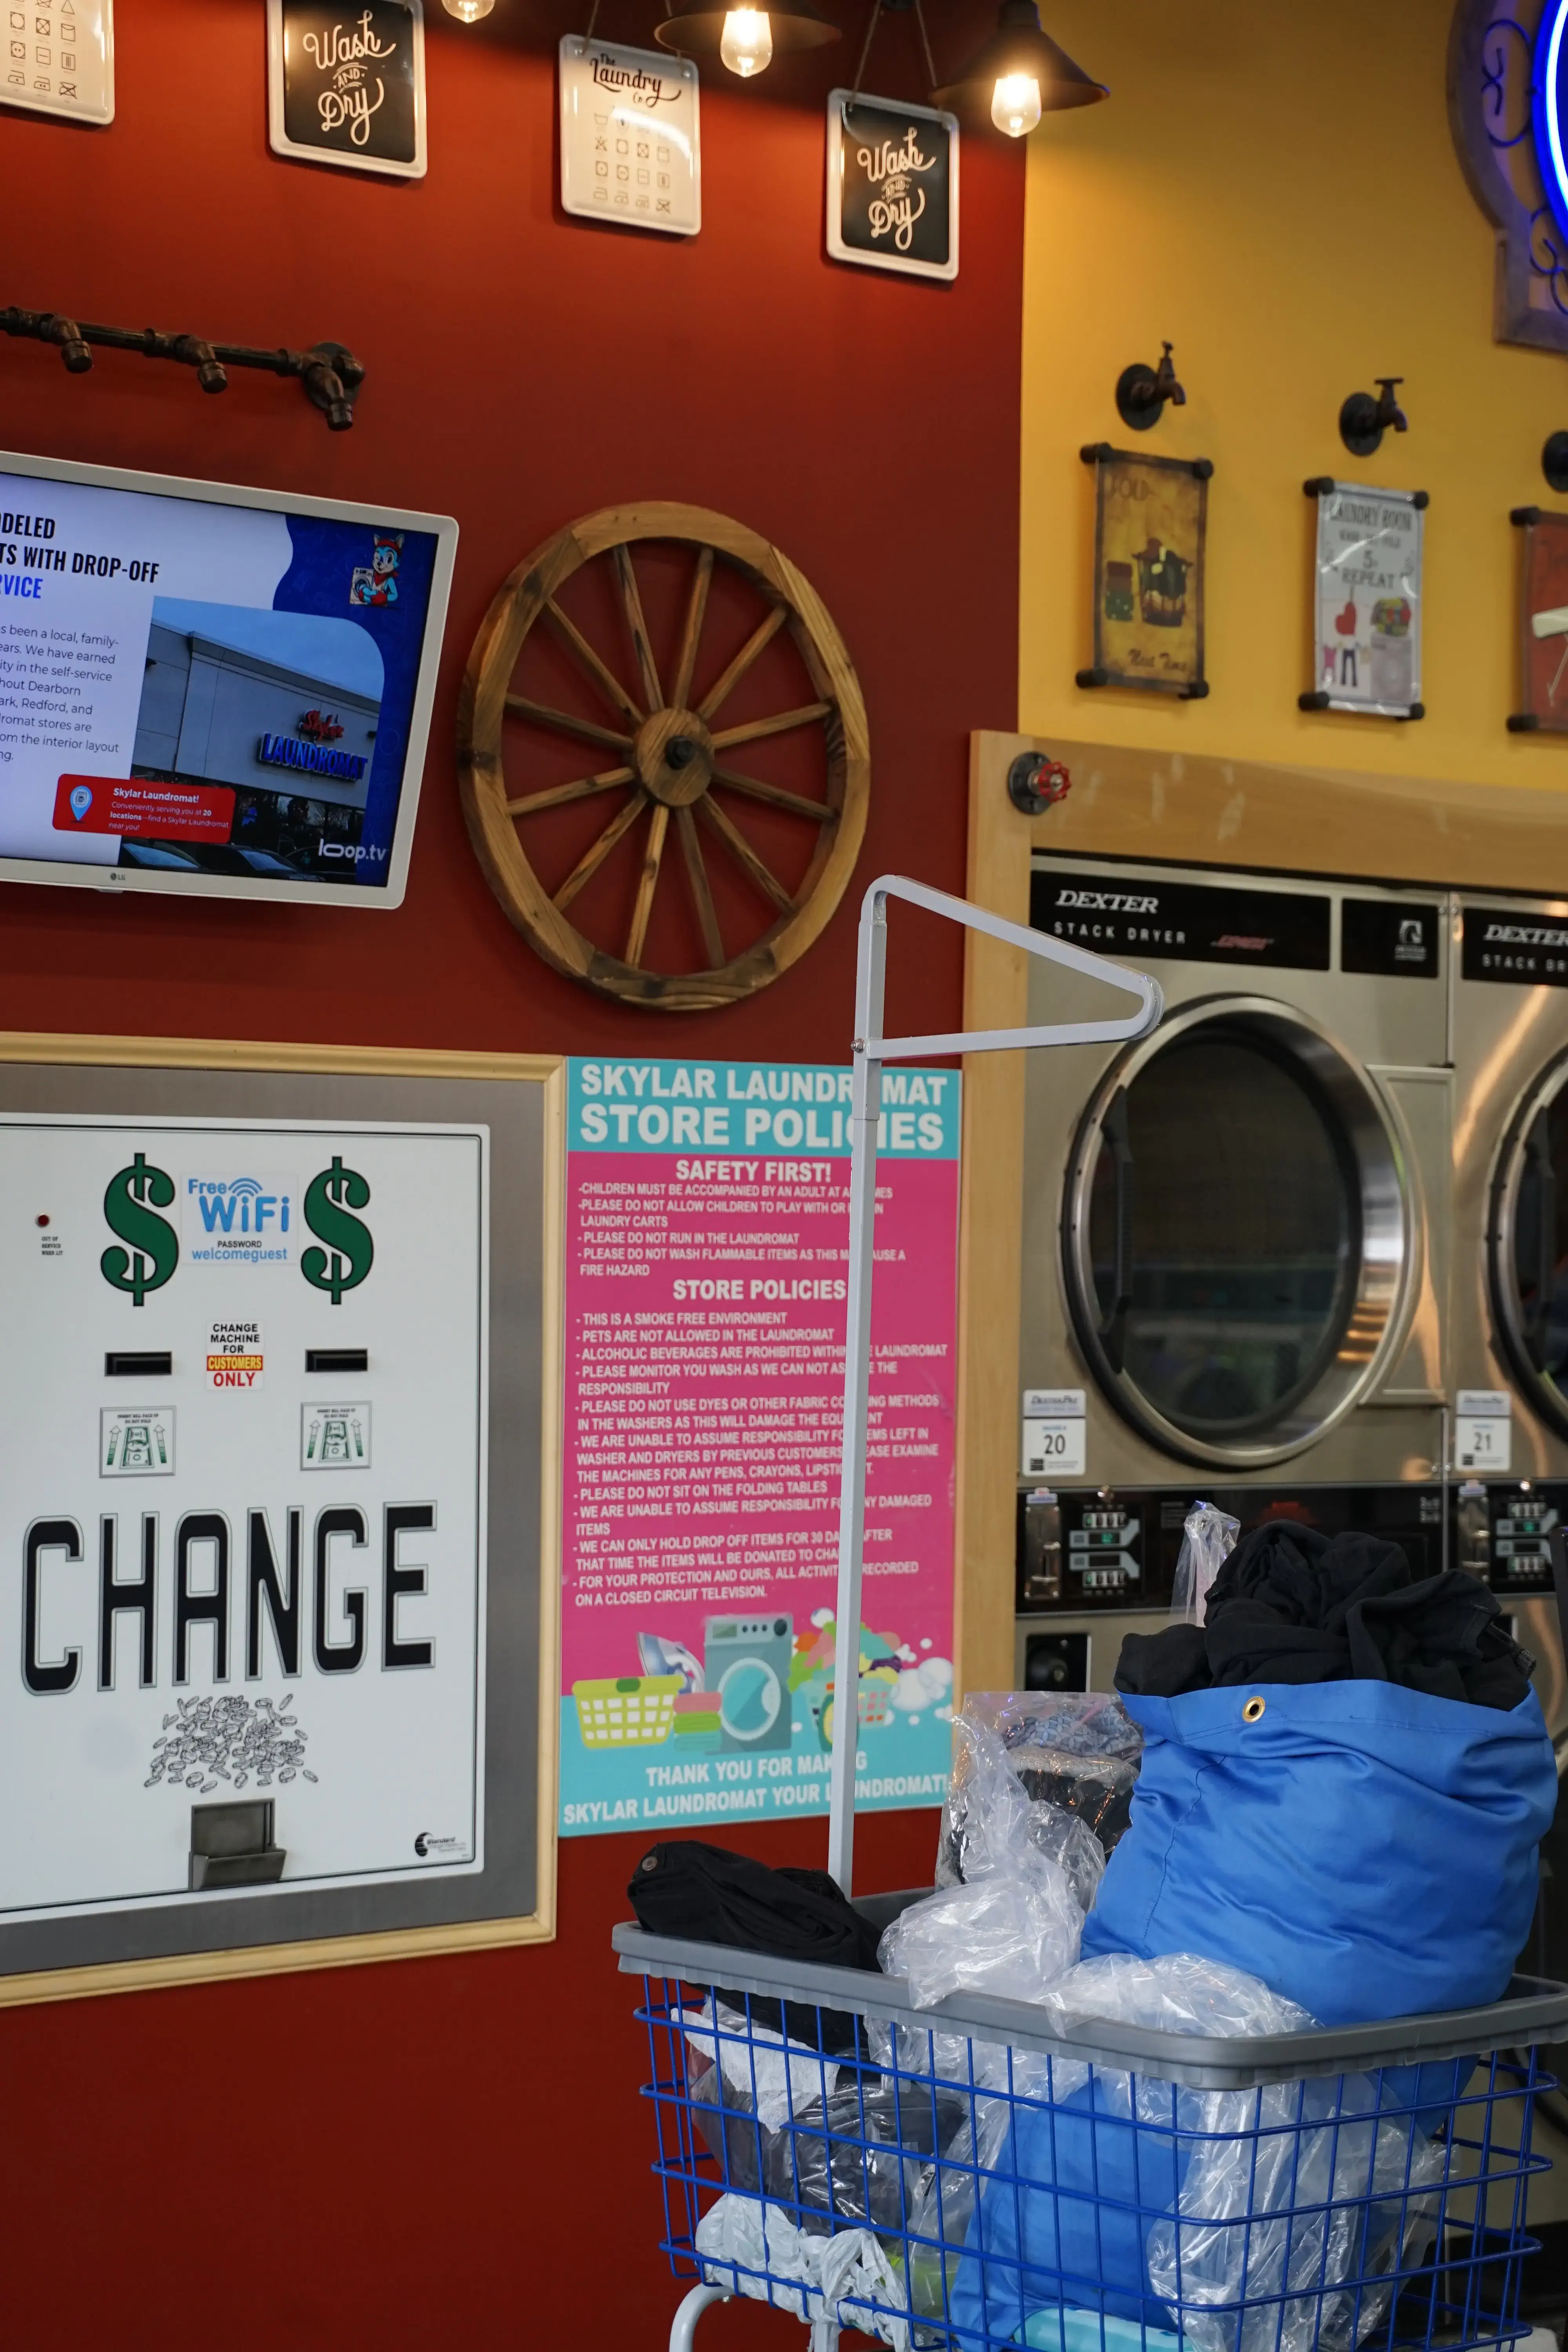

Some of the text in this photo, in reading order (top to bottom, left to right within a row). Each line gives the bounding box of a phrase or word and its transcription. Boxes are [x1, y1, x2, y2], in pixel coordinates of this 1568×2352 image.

[303, 9, 396, 70] Wash
[600, 53, 616, 66] The
[338, 68, 361, 88] AND
[590, 58, 682, 108] Laundry
[318, 78, 385, 145] Dry
[857, 126, 937, 182] Wash
[868, 187, 925, 250] Dry
[0, 513, 55, 539] DELED
[24, 546, 66, 572] WITH
[72, 553, 159, 583] DROP-OFF
[10, 624, 38, 637] been
[51, 629, 78, 644] local,
[82, 633, 119, 649] family-
[25, 644, 44, 656] We
[47, 647, 74, 659] have
[77, 653, 115, 664] earned
[16, 661, 26, 672] in
[30, 664, 49, 674] the
[51, 666, 112, 681] self-service
[28, 681, 81, 695] Dearborn
[22, 698, 68, 714] Redford,
[71, 704, 93, 715] and
[38, 719, 71, 730] stores
[74, 724, 92, 732] are
[21, 733, 40, 745] the
[42, 735, 83, 749] interior
[85, 740, 119, 753] layout
[261, 733, 368, 780] LAUNDROMAT
[113, 788, 199, 803] Skylar Laundromat!
[111, 801, 155, 813] Conveniently
[156, 807, 180, 815] serving
[167, 817, 187, 825] Skylar
[189, 819, 229, 829] Laundromat
[318, 838, 386, 864] loop.tv
[1055, 889, 1159, 914] DEXTER
[1054, 921, 1185, 944] STACK DRYER
[581, 1064, 948, 1105] SKYLAR LAUNDRMAT
[581, 1103, 730, 1145] STORE
[676, 1160, 831, 1182] SAFETY FIRST!
[188, 1178, 227, 1194] Free
[199, 1195, 290, 1232] WiFi
[580, 1216, 668, 1227] LAUNDRY CARTS
[584, 1232, 800, 1245] PLEASE DO NOT RUN IN THE LAUNDROMAT
[192, 1247, 287, 1263] welcomeguest
[580, 1264, 650, 1276] FIRE HAZARD
[673, 1279, 846, 1300] STORE POLICIES
[213, 1323, 258, 1332] CHANGE
[583, 1312, 788, 1326] THIS IS A SMOKE FREE ENVIRONMENT
[211, 1334, 260, 1343] MACHINE
[583, 1328, 835, 1343] PETS ARE NOT ALLOWED IN THE LAUNDROMAT
[223, 1345, 244, 1353] FOR
[582, 1347, 743, 1360] ALCOHOLIC BEVERAGES ARE
[209, 1356, 261, 1369] CUSTOMERS
[214, 1372, 255, 1387] ONLY
[578, 1382, 670, 1396] RESPONSIBILITY
[1044, 1434, 1066, 1454] 20
[1474, 1432, 1491, 1452] 21
[580, 1481, 828, 1501] PLEASE DO NOT SIT ON THE FOLDING TABLES
[576, 1523, 610, 1536] ITEMS
[579, 1541, 598, 1553] WE
[601, 1540, 624, 1552] CAN
[628, 1539, 657, 1552] ONLY
[660, 1537, 691, 1550] HOLD
[693, 1536, 725, 1549] DROP
[726, 1535, 748, 1548] OFF
[751, 1533, 783, 1546] ITEMS
[786, 1532, 809, 1545] FOR
[21, 1500, 437, 1696] CHANGE
[575, 1585, 767, 1607] ON A CLOSED CIRCUIT TELEVISION.
[646, 1751, 867, 1786] THANK YOU FOR MAG
[564, 1798, 638, 1825] SKYLAR
[643, 1788, 767, 1817] LAUNDROMAT
[772, 1783, 820, 1806] YOUR
